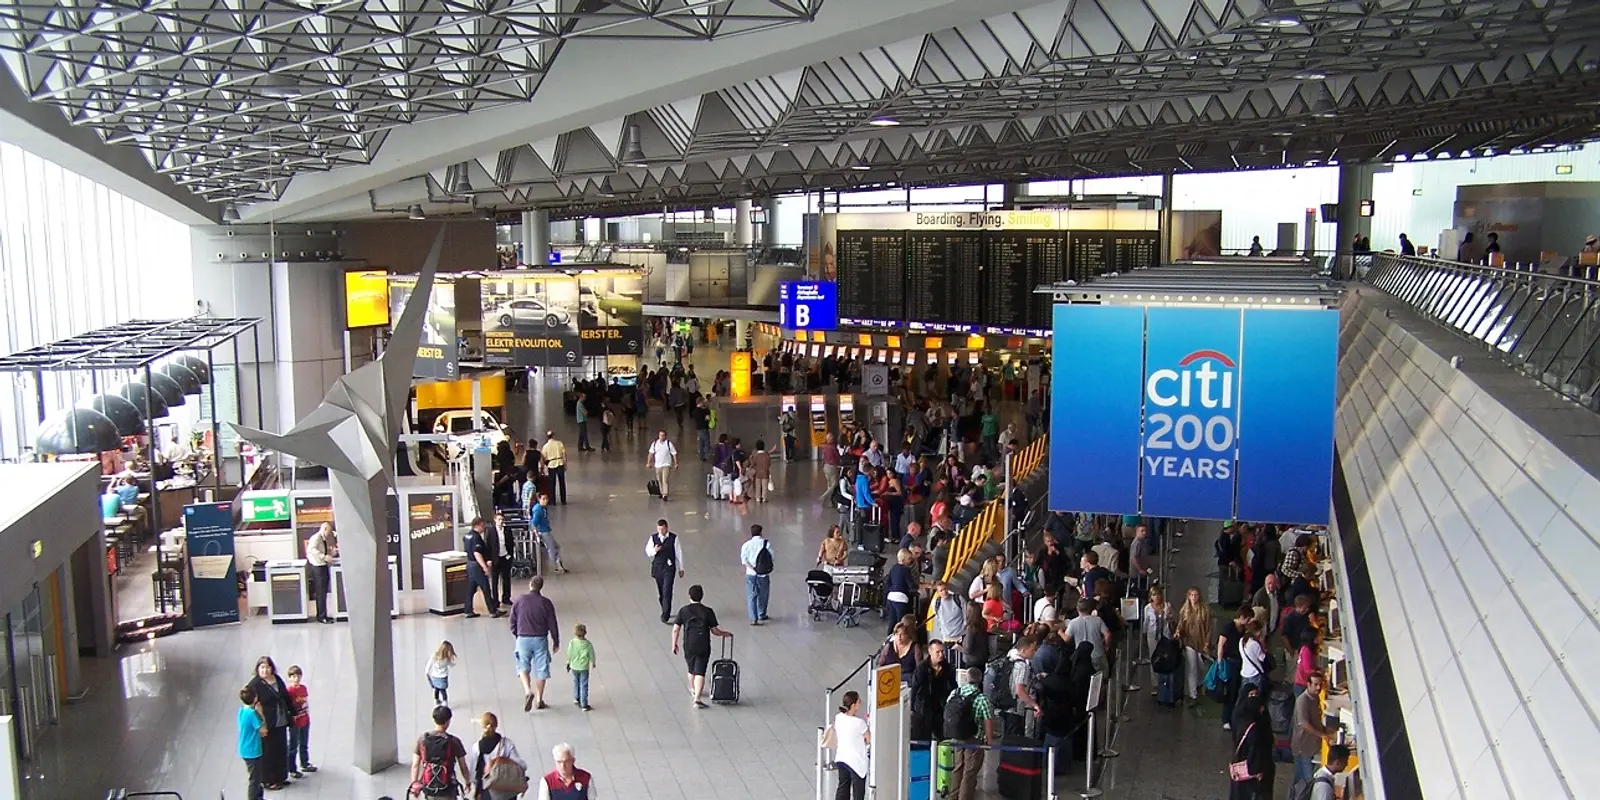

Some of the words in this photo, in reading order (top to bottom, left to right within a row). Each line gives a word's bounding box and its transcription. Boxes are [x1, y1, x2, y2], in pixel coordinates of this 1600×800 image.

[916, 212, 966, 227] Boarding.
[969, 212, 1005, 228] Flying.
[796, 304, 810, 327] B
[1147, 360, 1232, 408] citi
[1146, 413, 1234, 452] 200
[1145, 455, 1231, 480] YEARS
